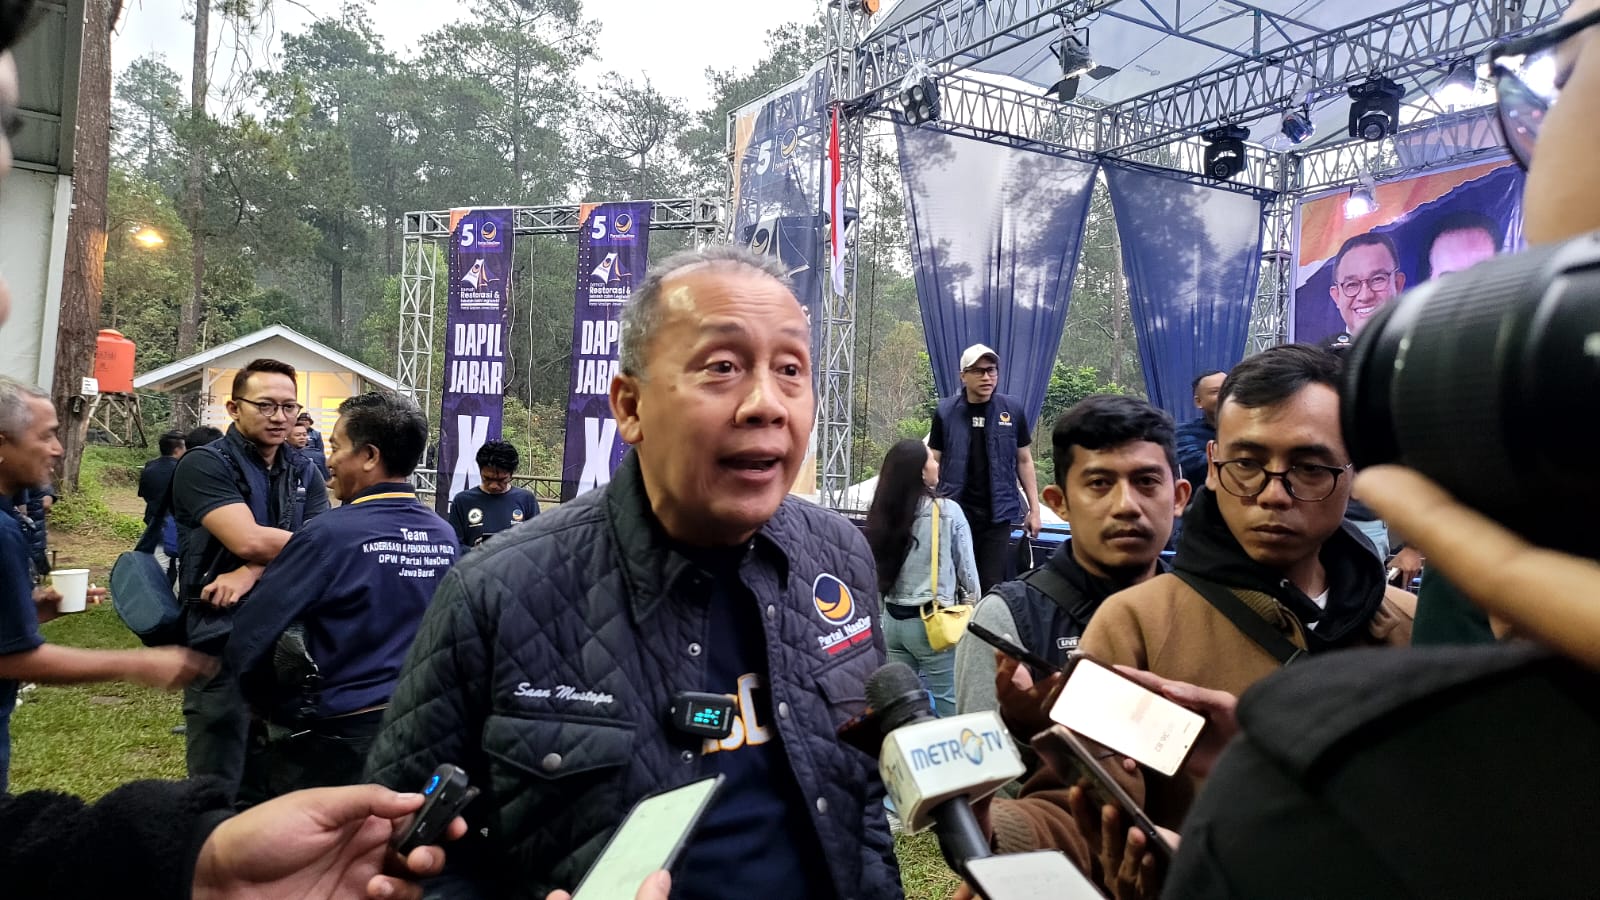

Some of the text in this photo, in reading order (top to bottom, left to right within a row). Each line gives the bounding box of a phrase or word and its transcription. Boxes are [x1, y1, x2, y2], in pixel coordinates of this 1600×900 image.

[756, 140, 772, 175] 5
[460, 223, 474, 247] 5
[591, 215, 607, 239] 5
[460, 290, 500, 299] Restorasi &
[589, 286, 625, 294] Restorasi
[454, 323, 503, 356] DAPIL
[448, 360, 503, 394] JABAR
[575, 359, 620, 395] JABA
[448, 414, 490, 501] X
[575, 416, 617, 498] X
[400, 528, 429, 541] Team
[378, 554, 450, 566] DPW Partai NasDem
[398, 567, 435, 578] Jawa Barat
[817, 628, 844, 647] Partai
[1060, 639, 1077, 647] LIVE
[513, 682, 551, 698] Saan
[981, 729, 1004, 752] TV
